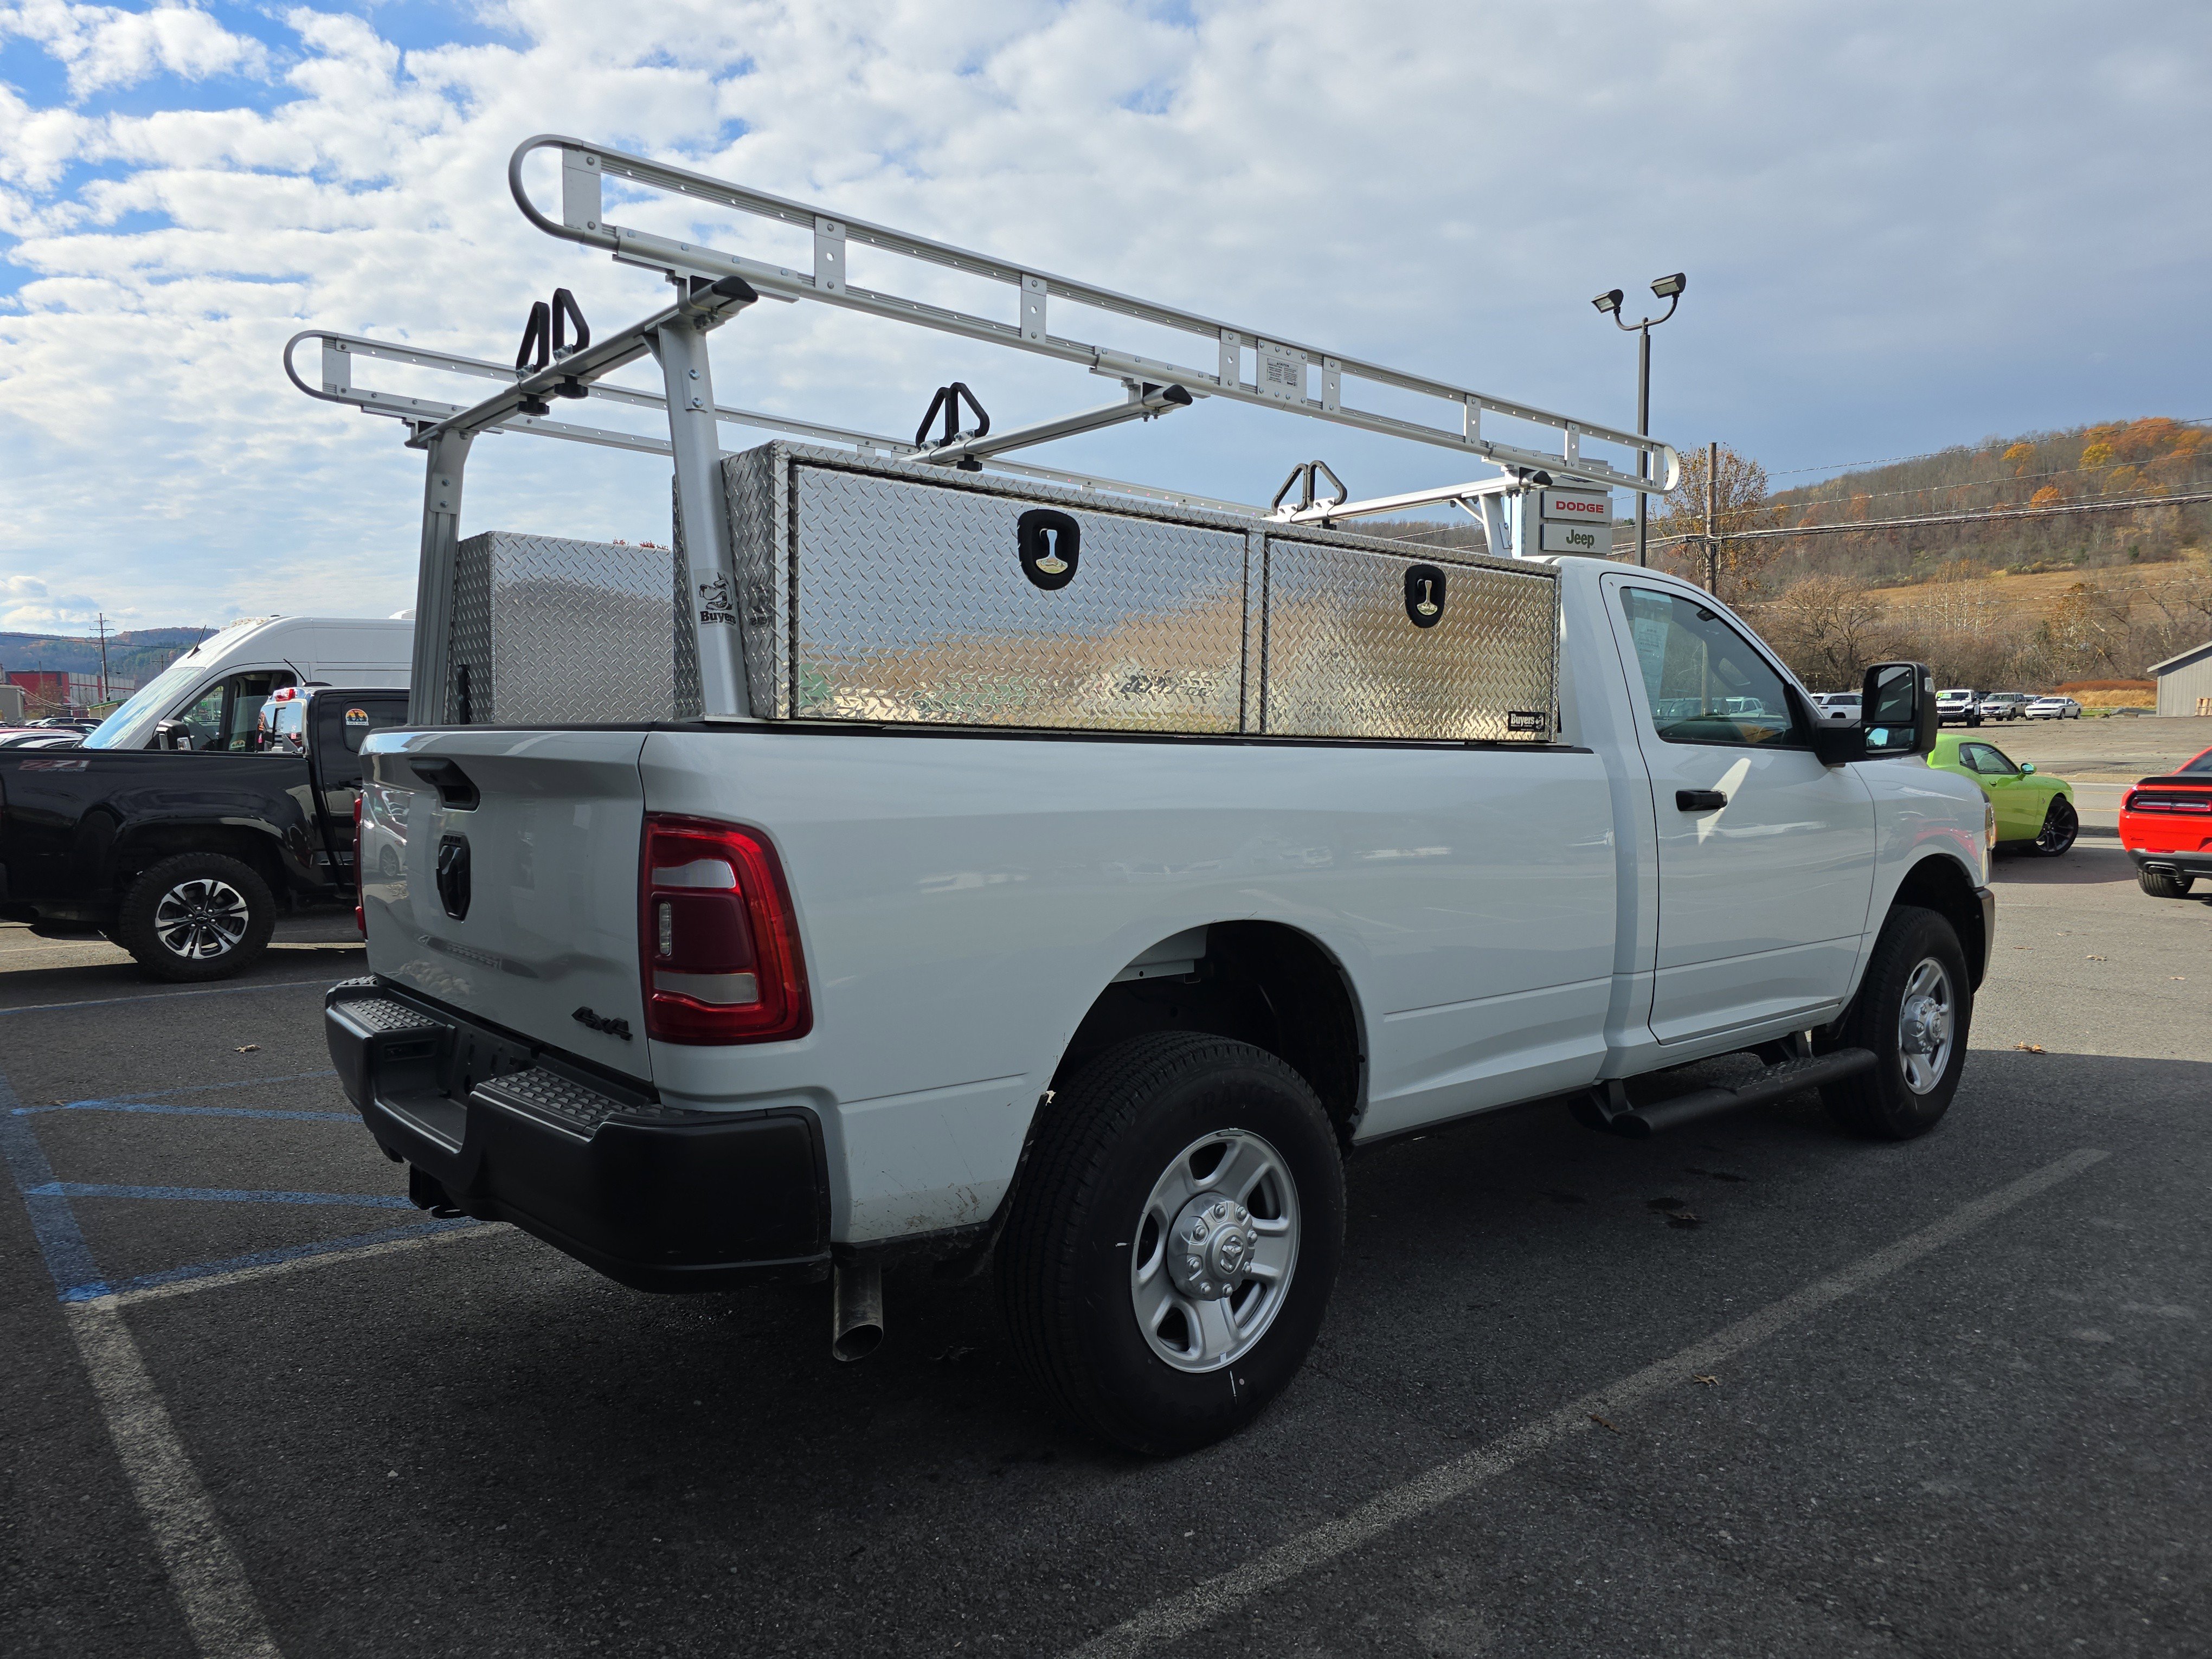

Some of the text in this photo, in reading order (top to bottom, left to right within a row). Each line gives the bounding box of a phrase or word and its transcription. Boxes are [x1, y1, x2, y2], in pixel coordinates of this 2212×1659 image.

[1556, 500, 1604, 513] DODGE
[1566, 529, 1594, 549] Jeep
[700, 611, 736, 624] Buyers
[1510, 713, 1535, 727] Buyers
[18, 760, 91, 770] Z71
[443, 835, 461, 844] RAM
